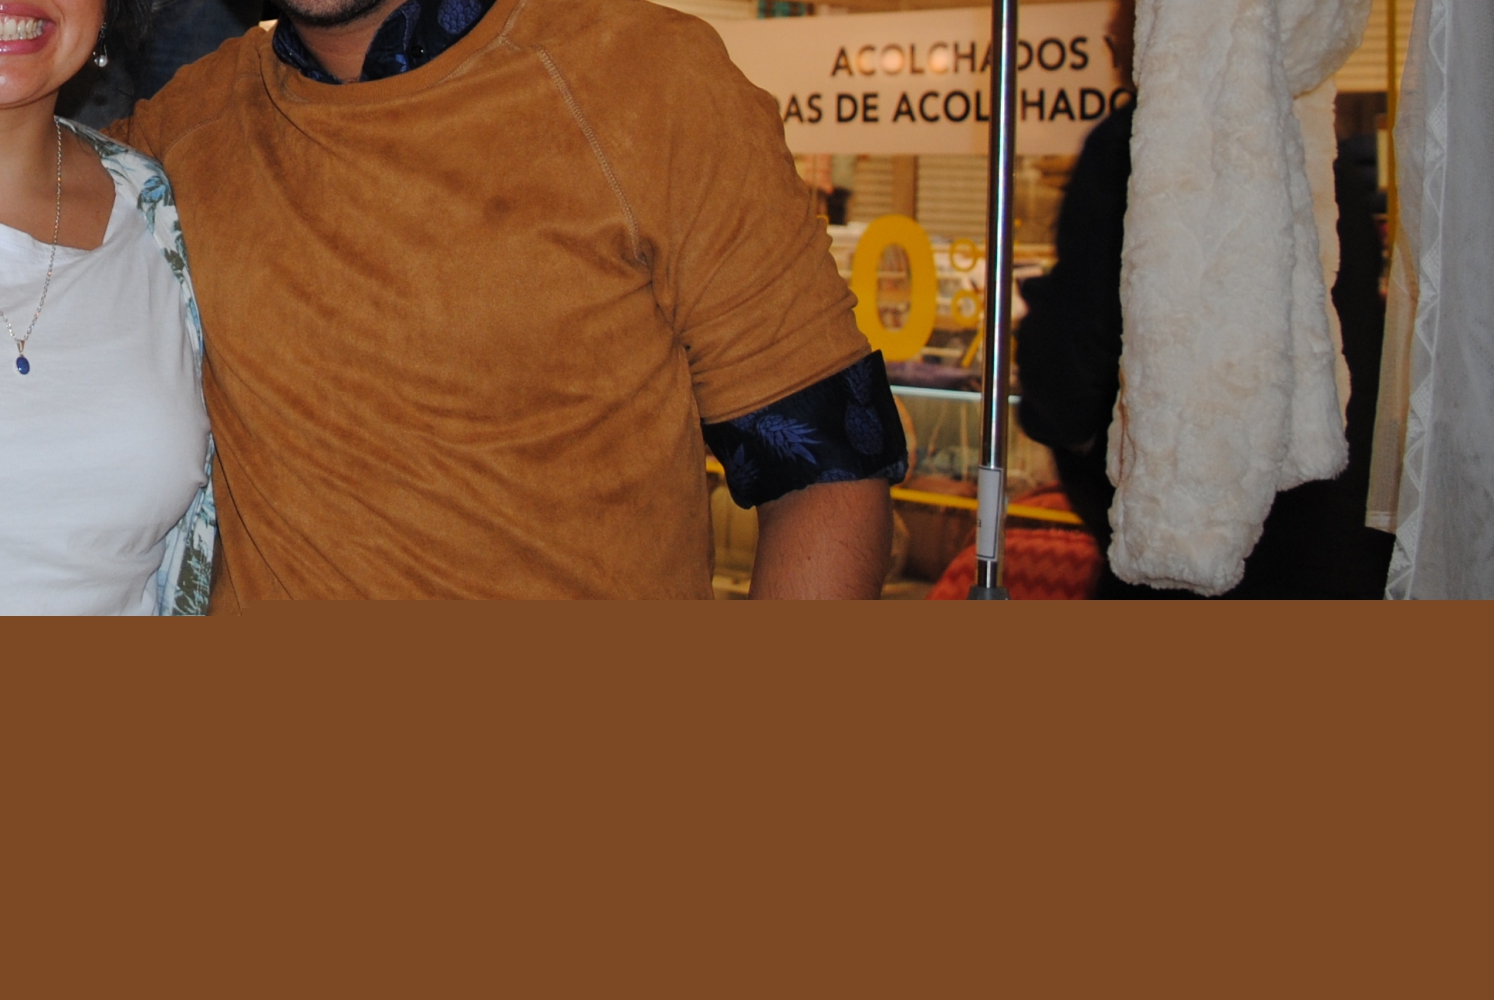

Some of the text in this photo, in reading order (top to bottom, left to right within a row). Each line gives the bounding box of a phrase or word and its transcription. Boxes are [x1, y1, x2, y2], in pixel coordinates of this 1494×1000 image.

[782, 87, 1137, 124] AS DE ACOLHADO
